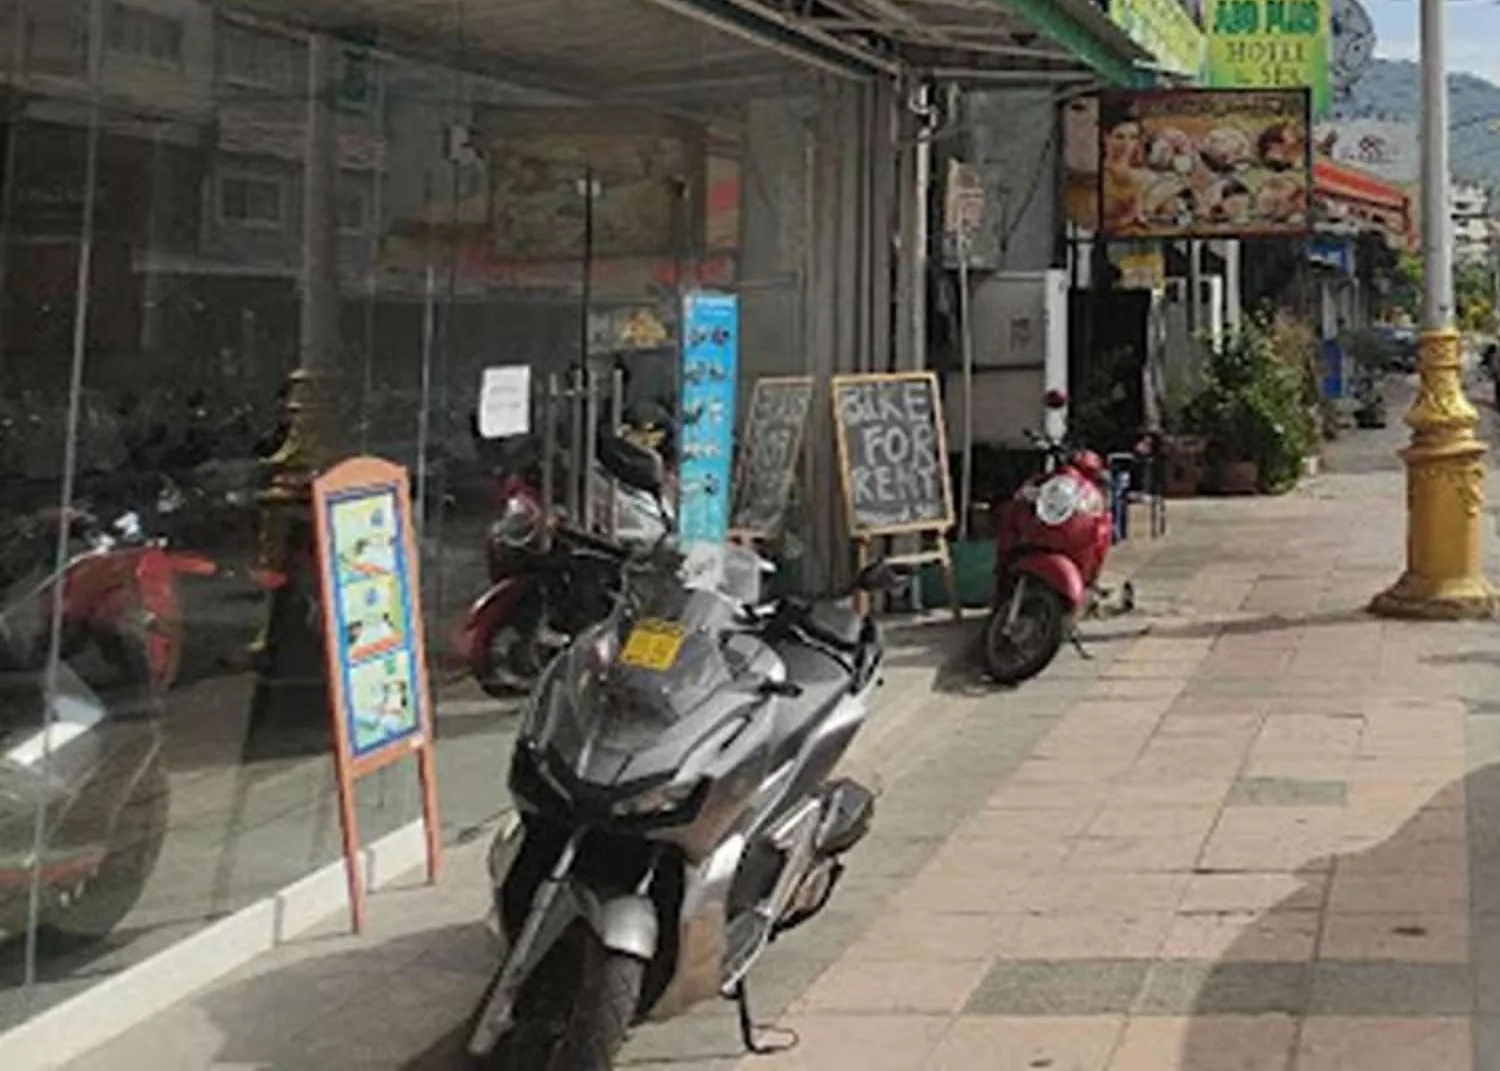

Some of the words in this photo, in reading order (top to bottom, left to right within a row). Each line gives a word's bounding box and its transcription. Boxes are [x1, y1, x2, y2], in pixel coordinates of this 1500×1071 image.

[1225, 41, 1307, 64] HOTEL
[841, 381, 930, 425] BIKE
[863, 425, 937, 475] FOR
